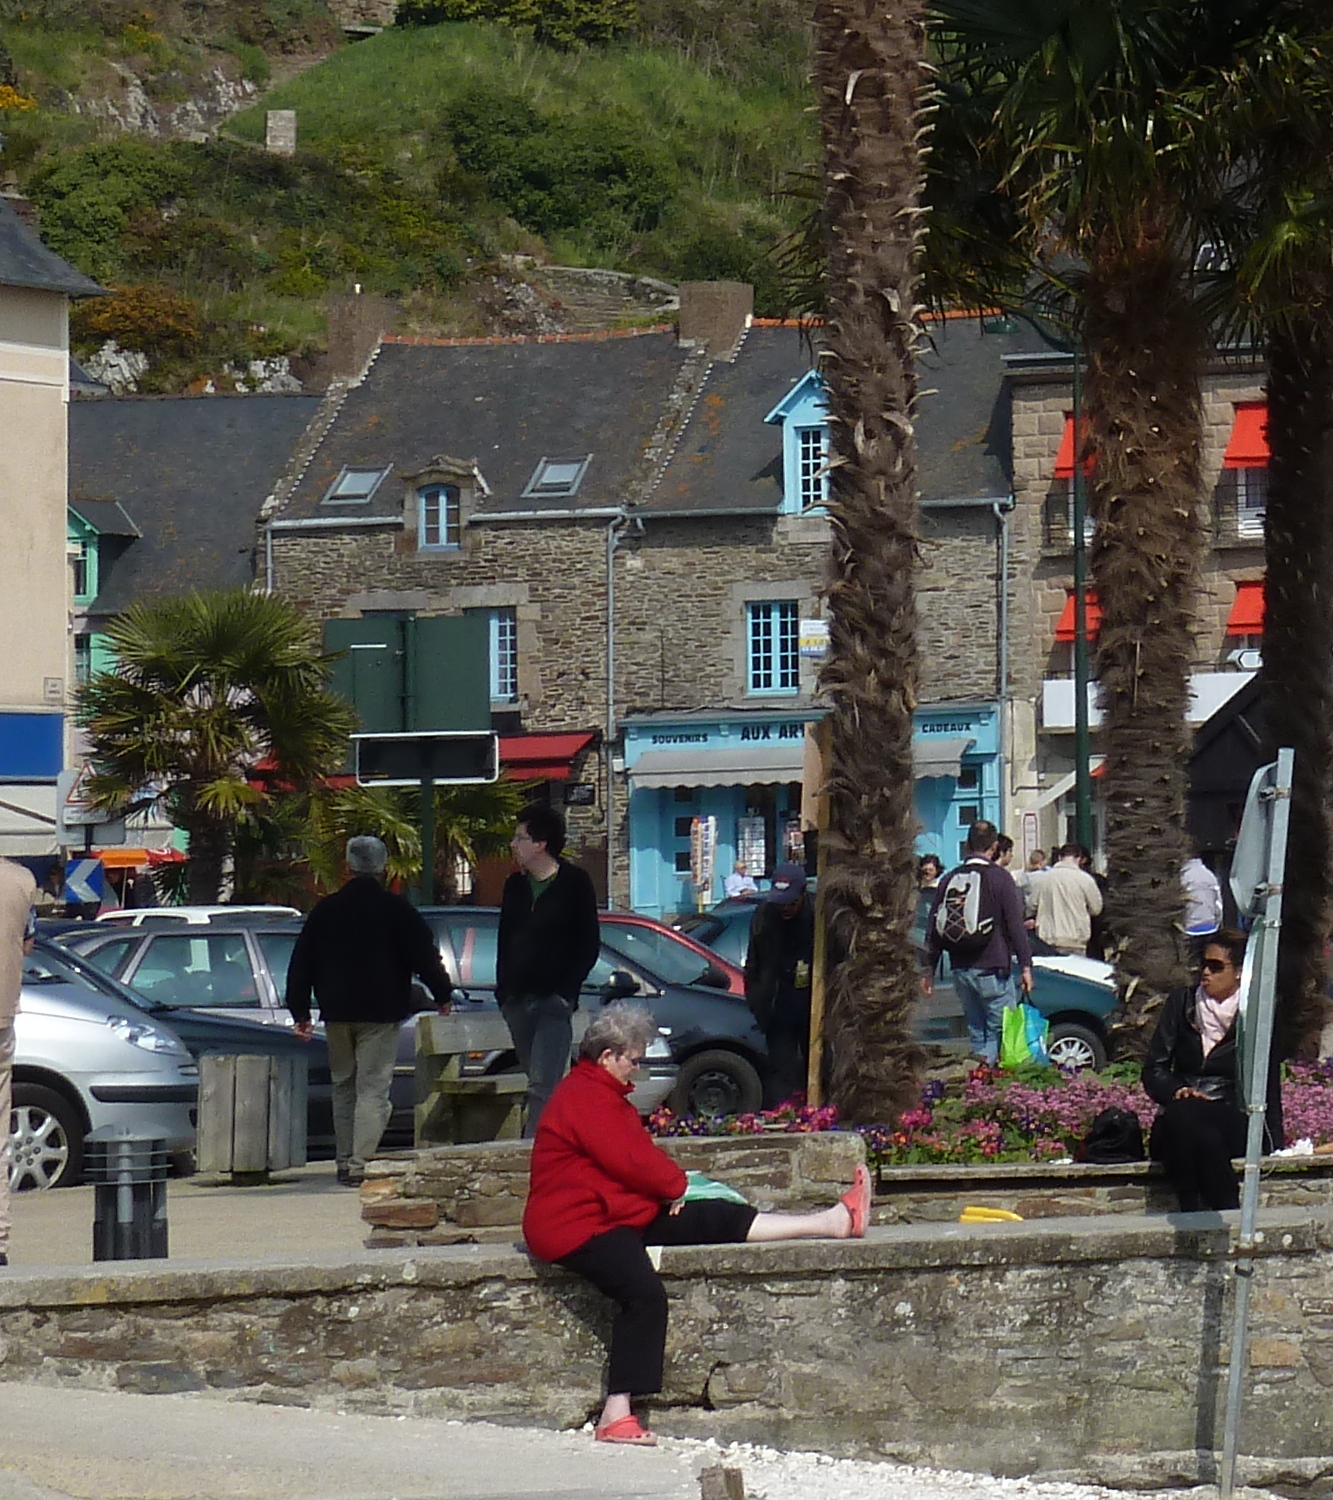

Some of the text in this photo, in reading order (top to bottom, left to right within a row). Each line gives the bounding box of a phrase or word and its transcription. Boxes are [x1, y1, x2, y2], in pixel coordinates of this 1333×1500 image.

[740, 723, 805, 741] AUX ART
[922, 722, 972, 733] CADEAUX
[651, 733, 708, 745] SOUVENIRS
